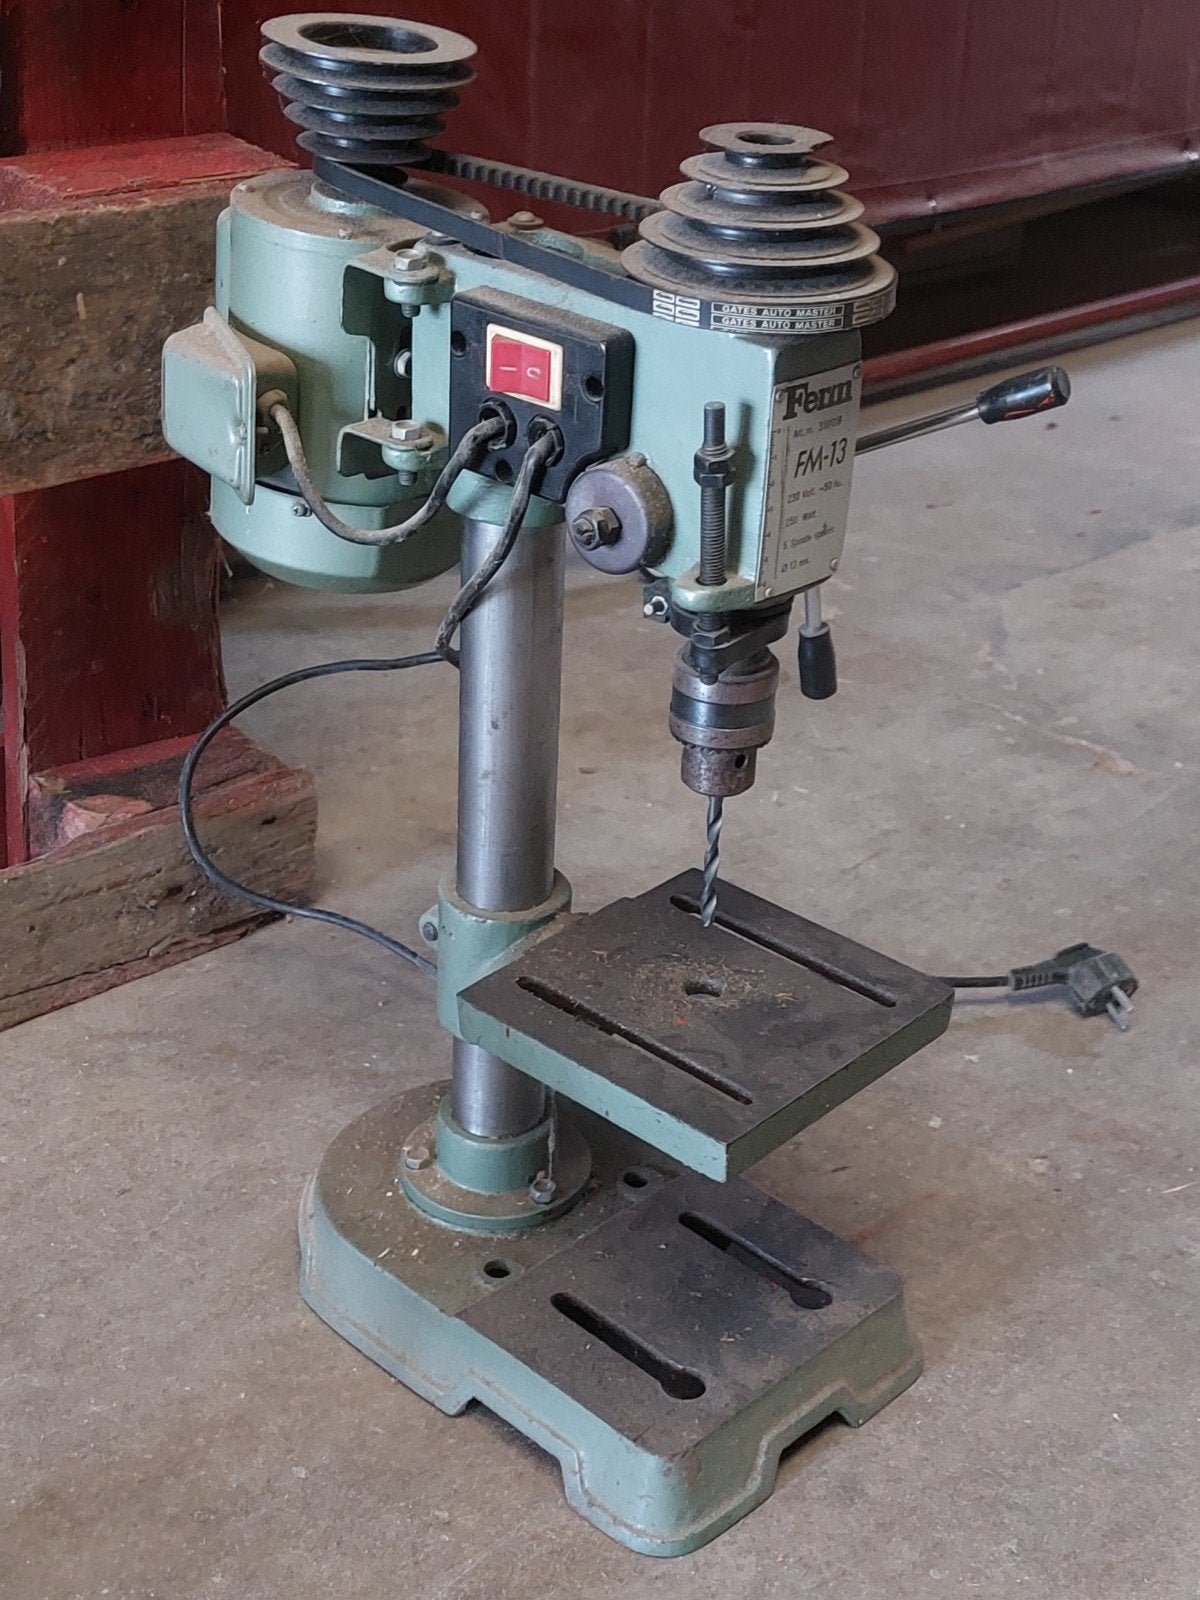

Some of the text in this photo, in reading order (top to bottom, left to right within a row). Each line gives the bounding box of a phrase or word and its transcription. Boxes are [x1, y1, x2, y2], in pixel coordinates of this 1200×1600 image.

[720, 315, 836, 330] GATES AUTO MASTER
[721, 304, 836, 318] GATES AUTO MASTER
[782, 380, 853, 421] Ferm
[793, 437, 848, 479] FM-13
